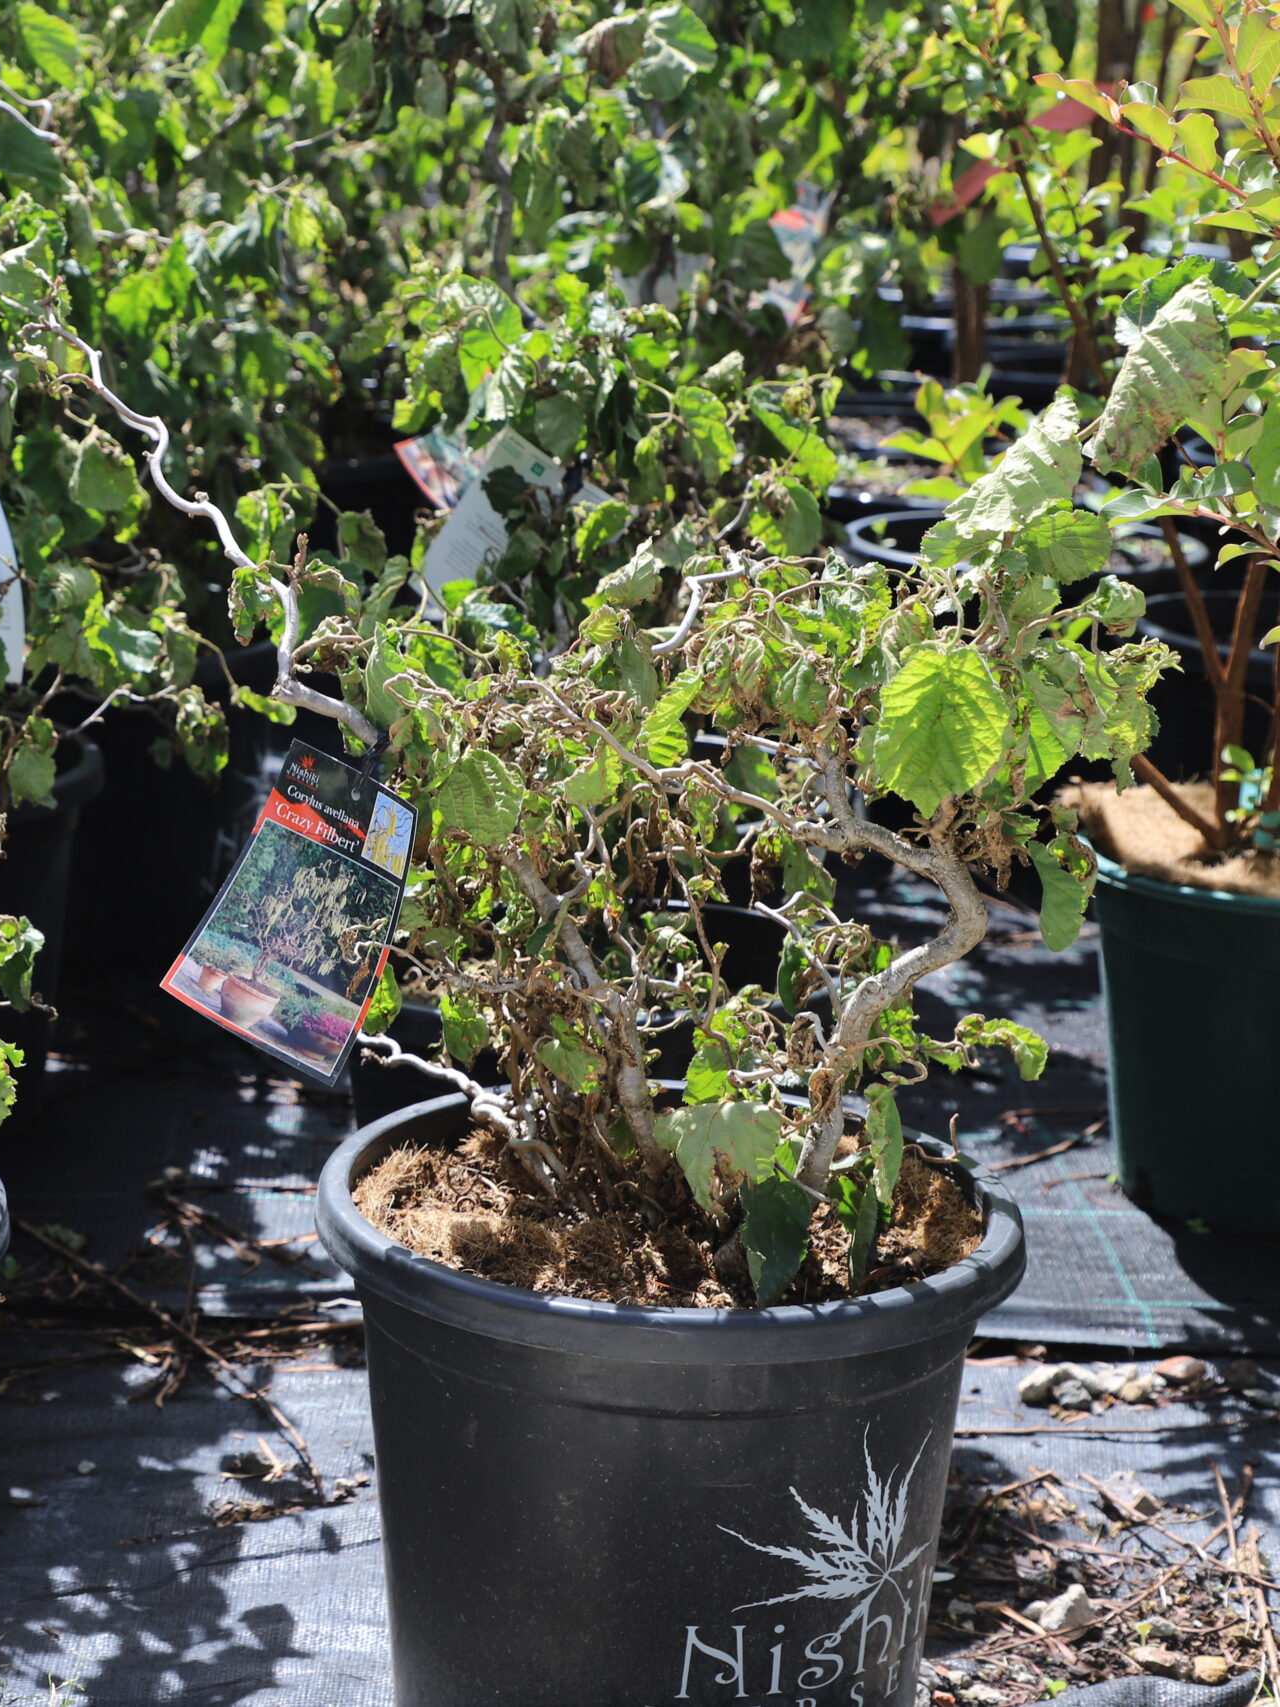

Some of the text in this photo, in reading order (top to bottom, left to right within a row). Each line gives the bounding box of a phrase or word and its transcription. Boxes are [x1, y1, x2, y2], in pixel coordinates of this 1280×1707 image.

[289, 762, 320, 783] Nishiki
[287, 785, 360, 829] Corylus avellana
